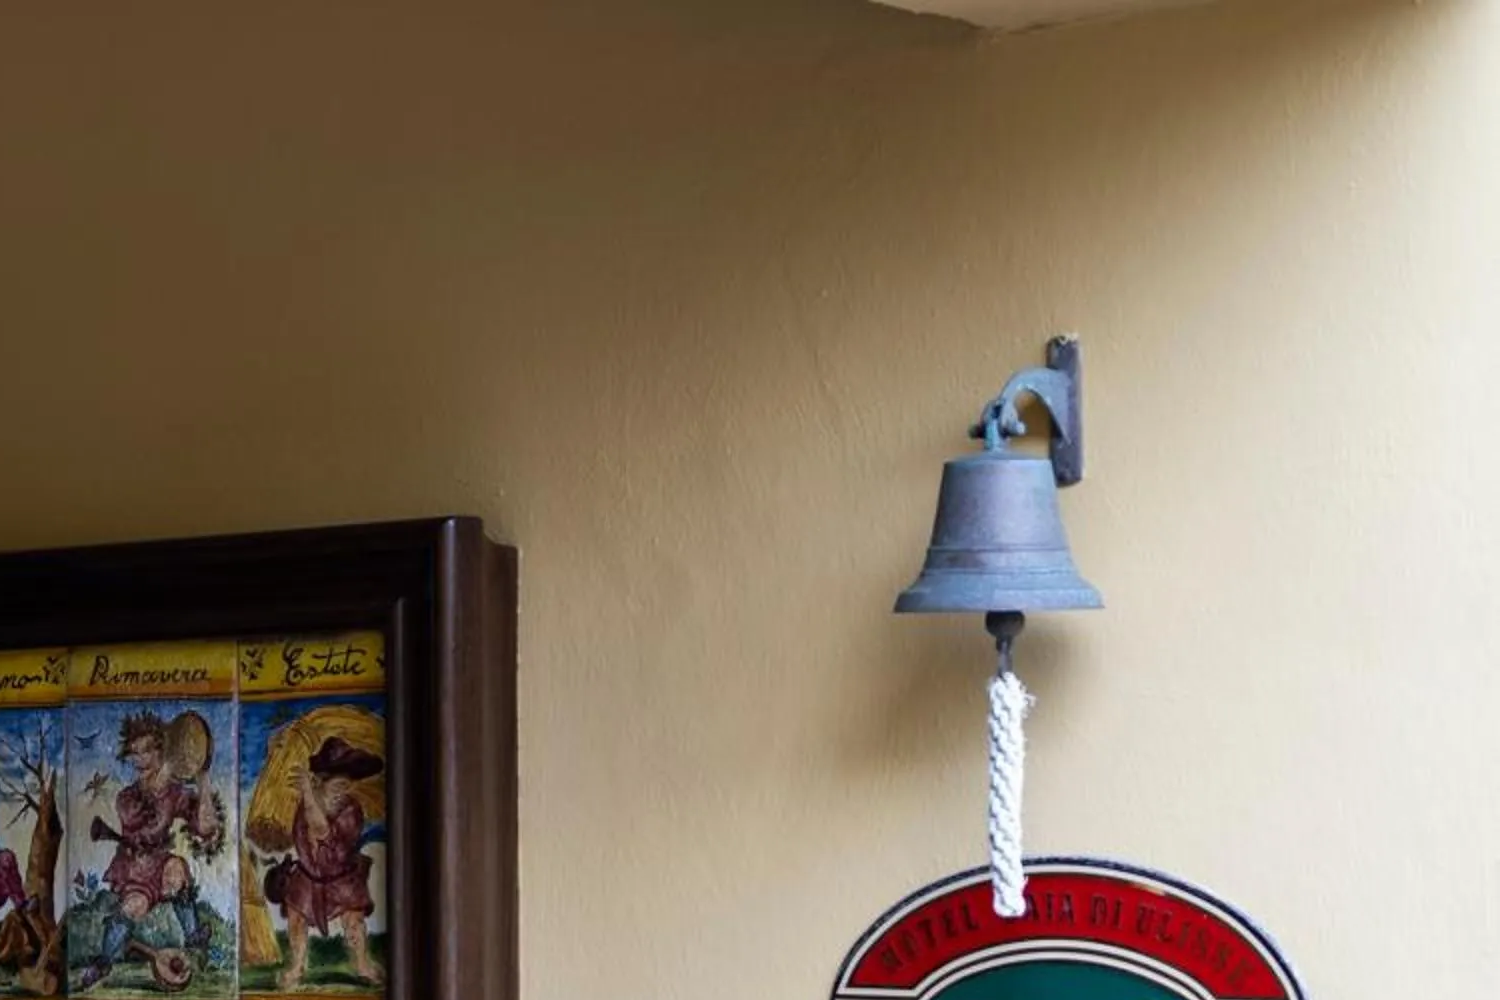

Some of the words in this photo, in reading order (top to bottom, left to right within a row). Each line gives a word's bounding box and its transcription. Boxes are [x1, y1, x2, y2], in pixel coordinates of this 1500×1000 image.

[879, 902, 980, 974] HOTEL
[1007, 891, 1076, 927] AIA
[1090, 895, 1124, 930] DI
[1134, 902, 1255, 987] ULISSE
